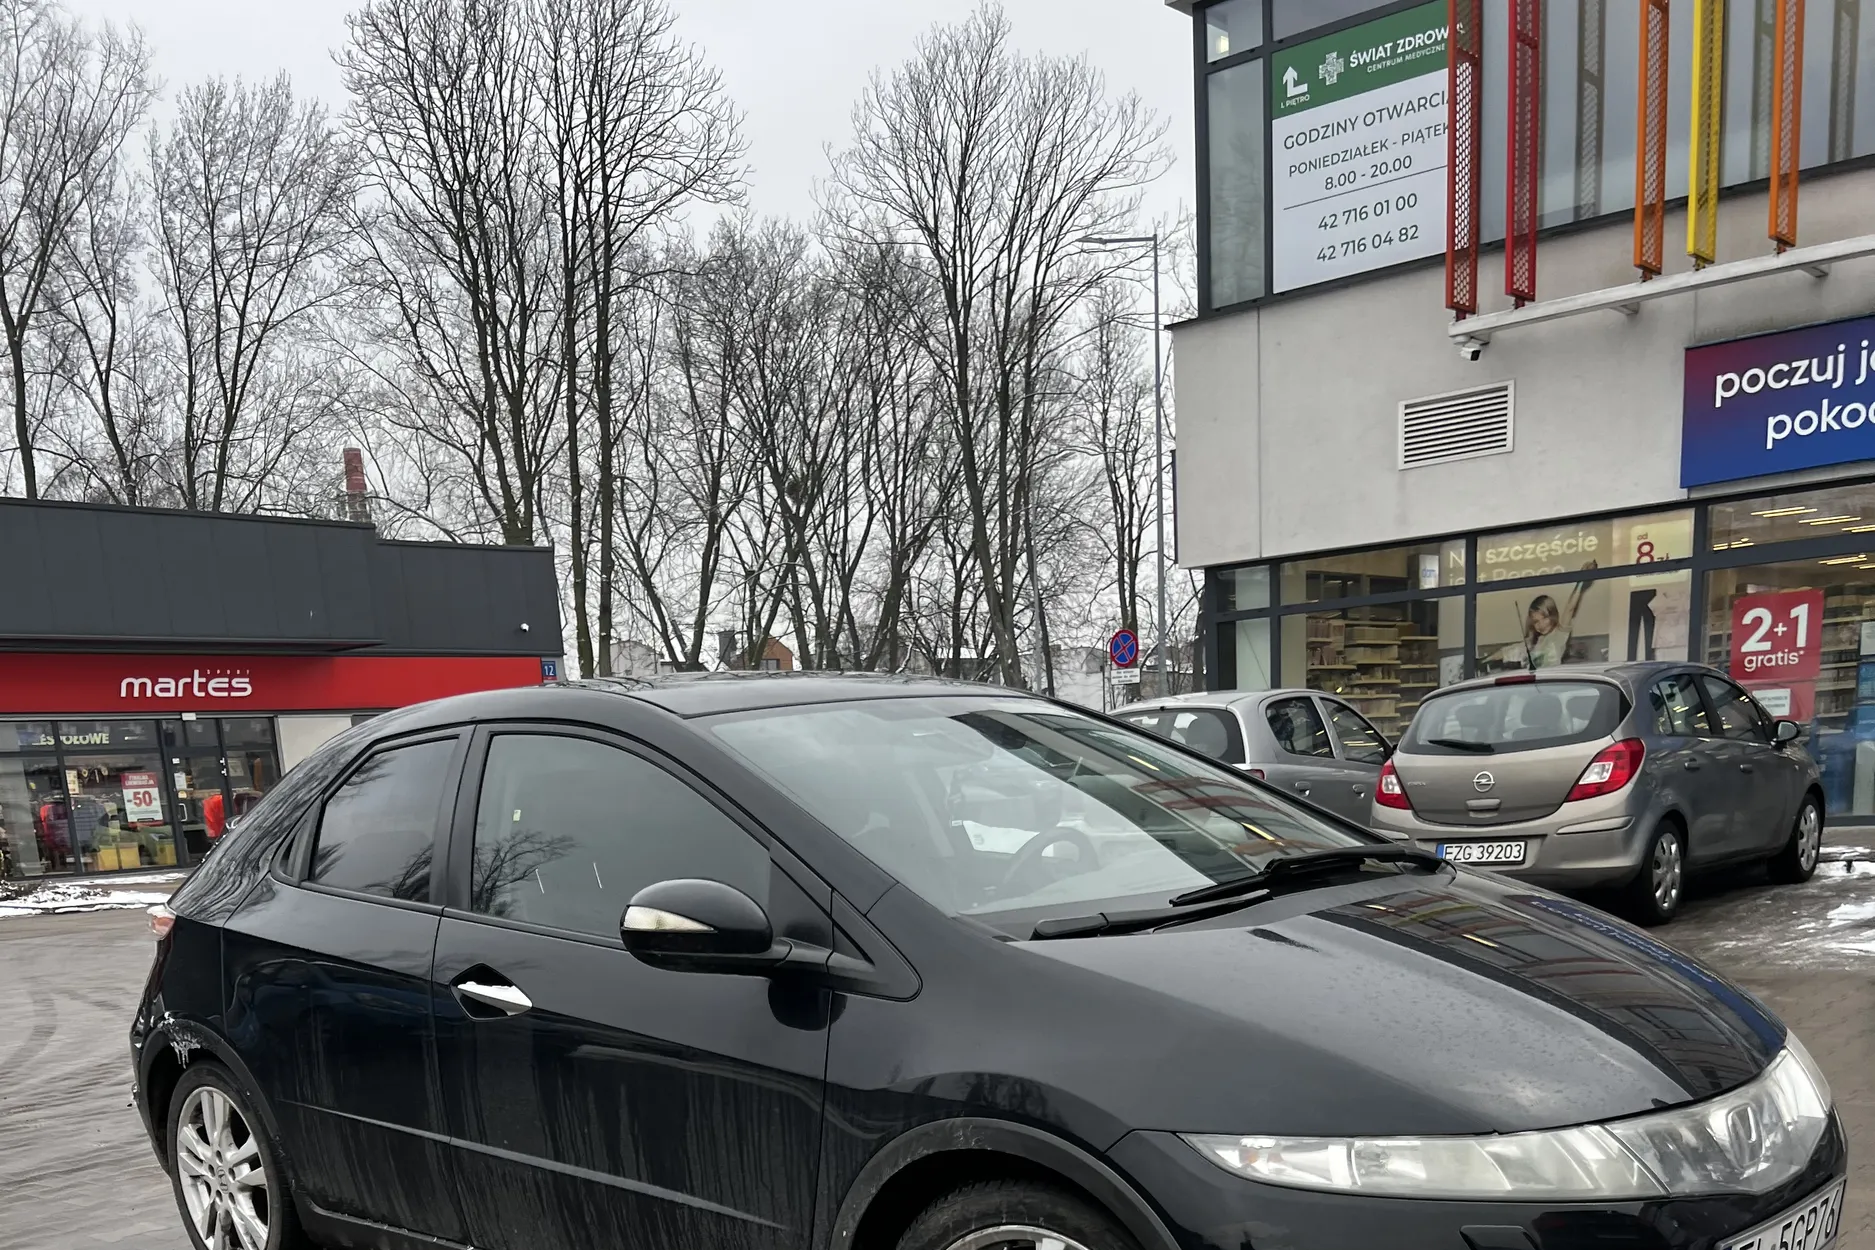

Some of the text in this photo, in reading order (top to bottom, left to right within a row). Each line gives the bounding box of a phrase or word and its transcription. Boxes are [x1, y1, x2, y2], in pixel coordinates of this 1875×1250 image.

[1349, 42, 1393, 68] ŚWIAT
[1367, 43, 1446, 73] CENTRUM MEDYCZNE
[1284, 90, 1448, 150] GODZINY OTWARCI
[1289, 138, 1389, 178] PONIEDZIAŁEK
[1324, 170, 1356, 191] 8.00
[1370, 155, 1413, 178] 20.00
[1317, 192, 1418, 231] 42 716 01 00
[1316, 223, 1420, 263] 42 716 04 82
[1715, 339, 1875, 408] poczuj j
[1485, 531, 1599, 565] szczęście
[1740, 603, 1809, 653] 2+1
[120, 669, 252, 698] martes
[544, 665, 555, 676] 12
[1444, 843, 1522, 861] EZG 39203
